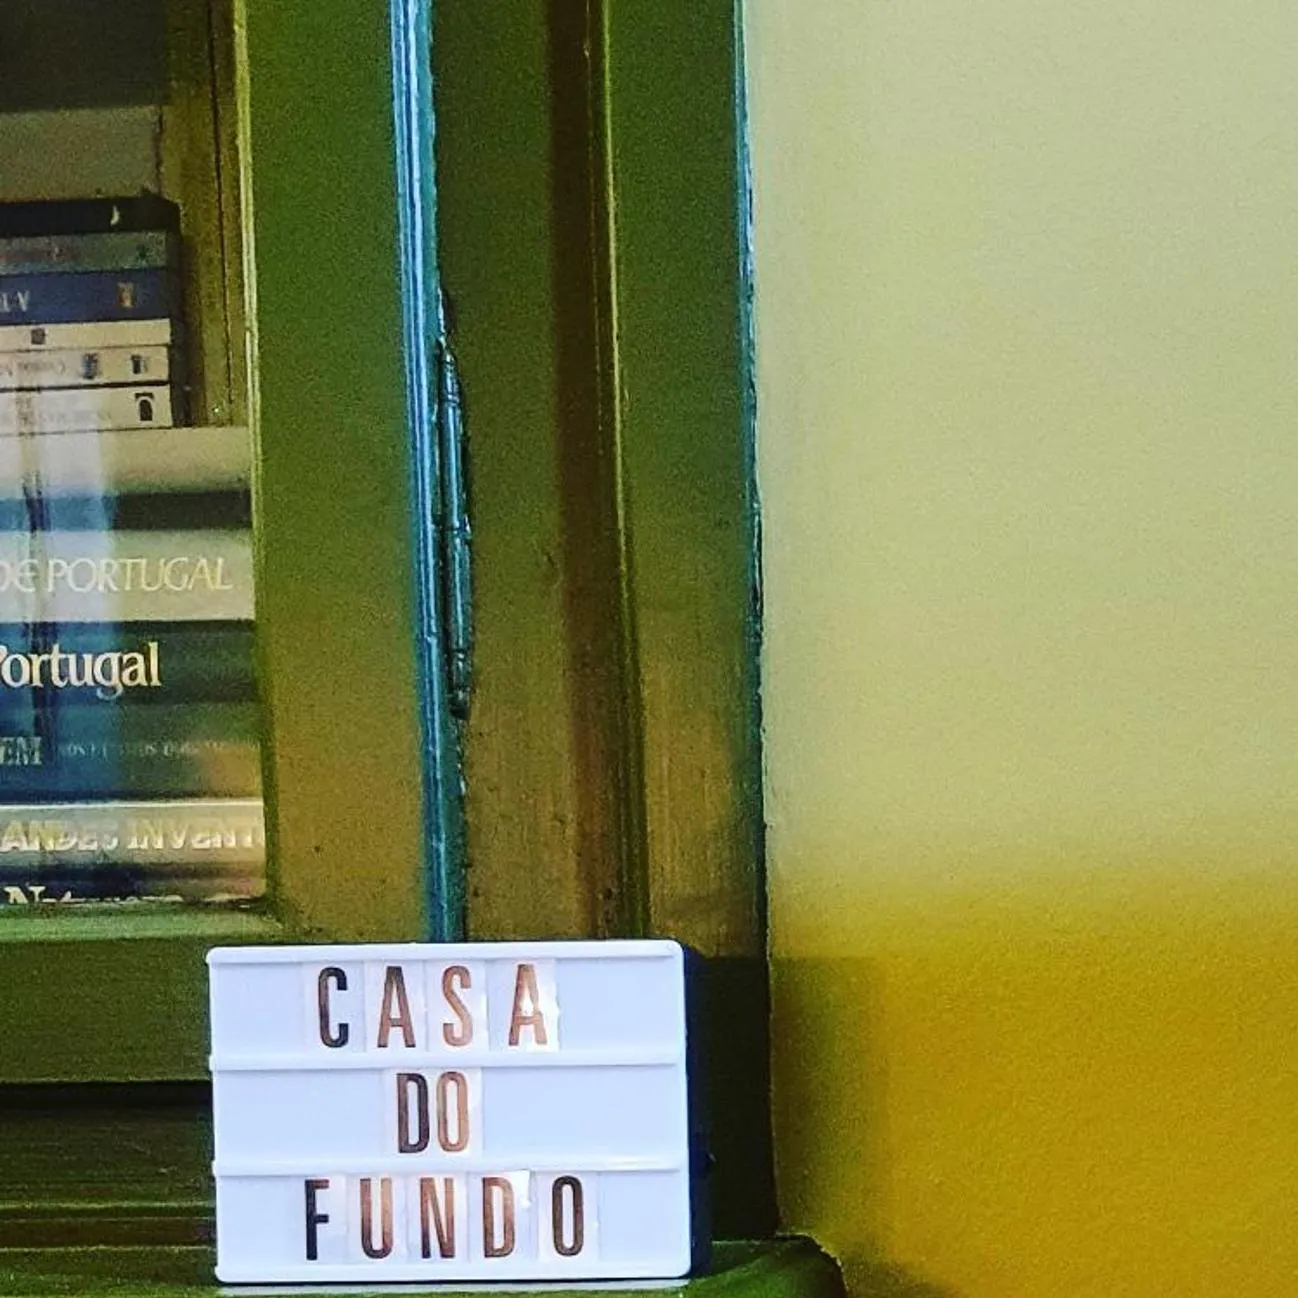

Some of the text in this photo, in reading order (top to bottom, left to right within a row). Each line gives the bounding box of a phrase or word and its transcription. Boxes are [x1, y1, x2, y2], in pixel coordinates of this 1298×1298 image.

[47, 556, 234, 593] PORTUGAL
[0, 641, 162, 700] ortugal
[317, 963, 548, 1049] CASA
[396, 1071, 470, 1154] DO
[305, 1175, 585, 1261] FUNDO
